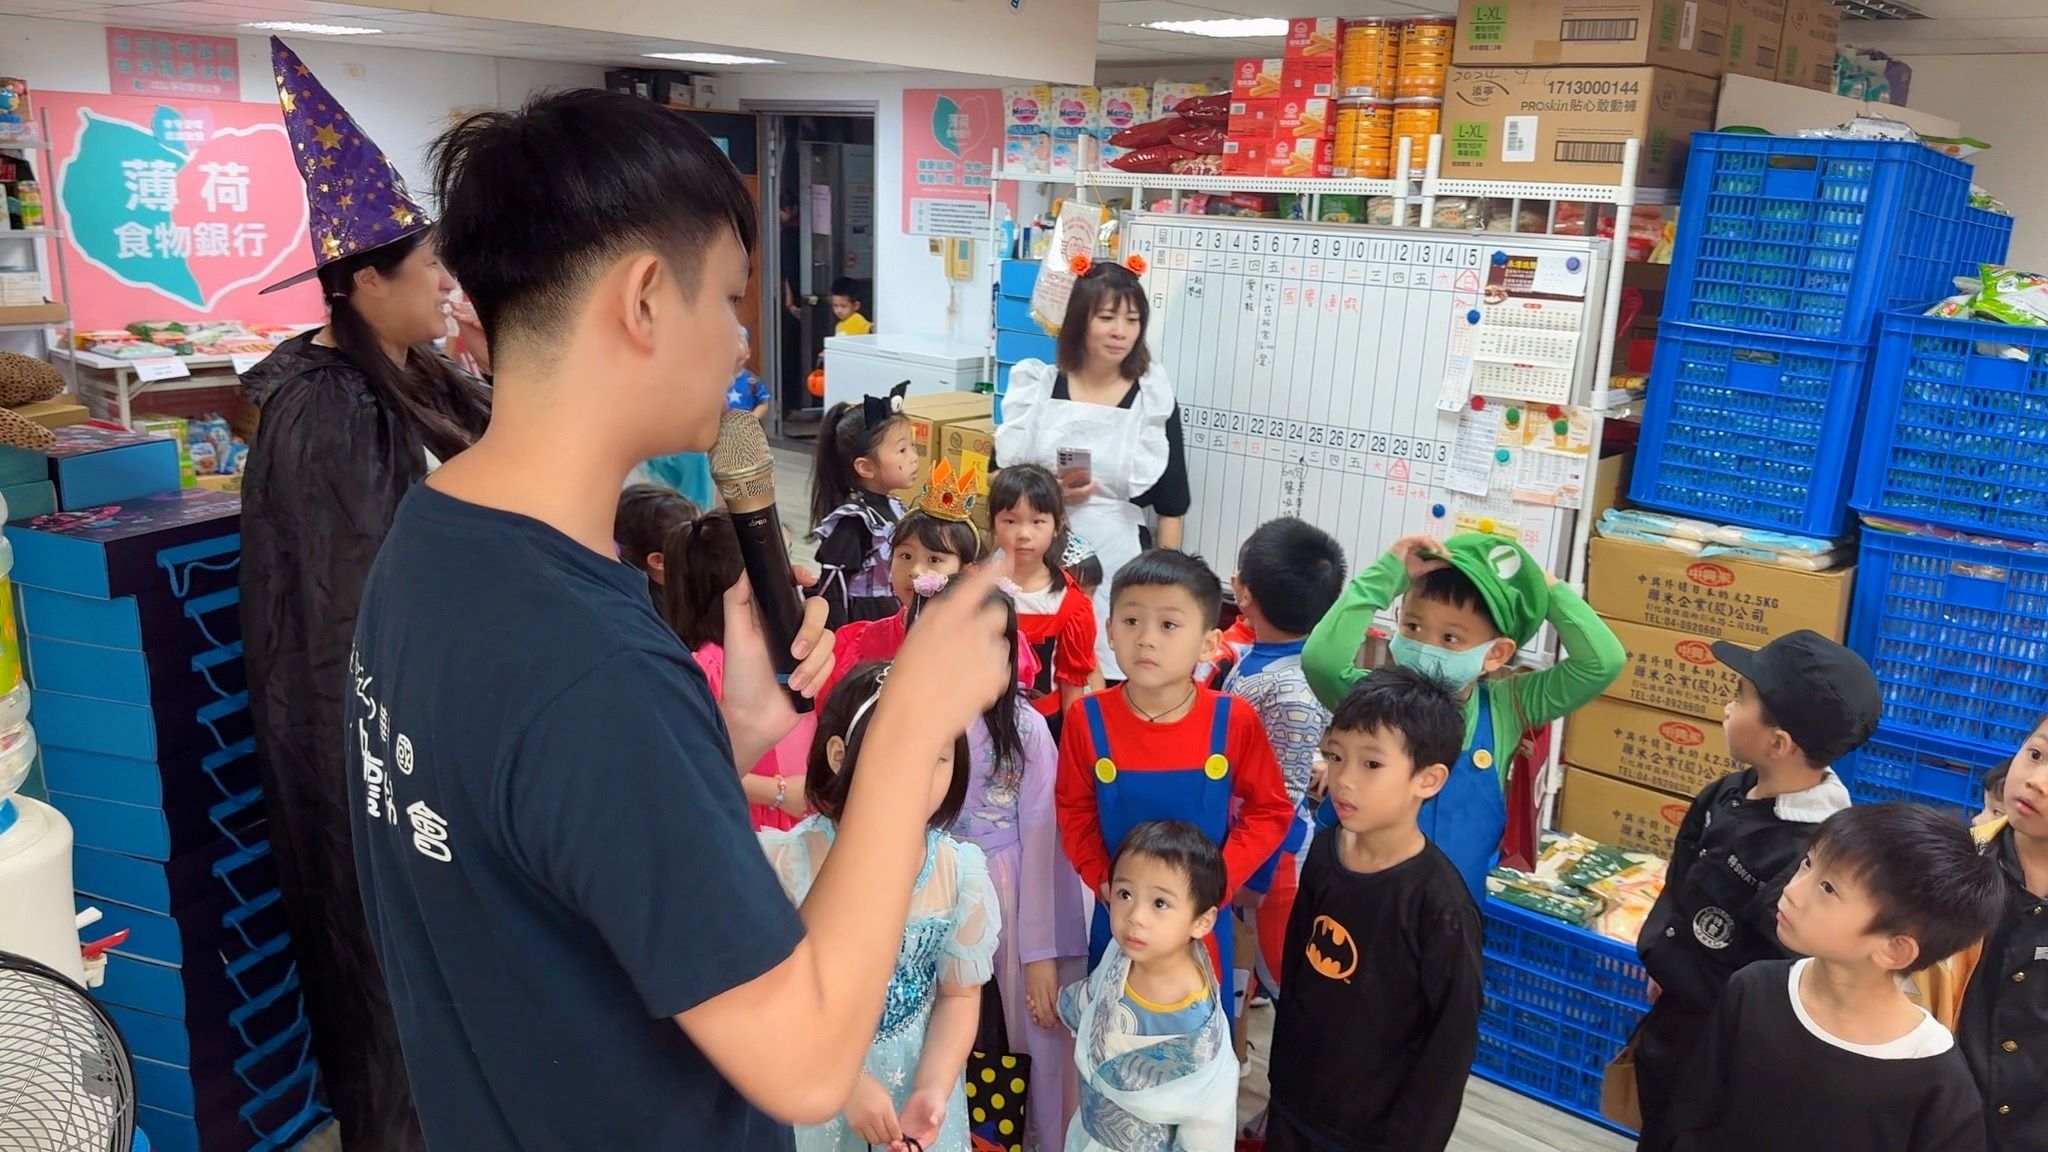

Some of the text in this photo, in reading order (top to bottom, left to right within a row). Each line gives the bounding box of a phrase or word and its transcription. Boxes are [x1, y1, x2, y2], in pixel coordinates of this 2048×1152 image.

[1476, 7, 1502, 20] L-XL
[1549, 81, 1639, 96] 1713000144
[1458, 125, 1484, 138] L-XL
[121, 158, 250, 213] 薄荷
[113, 222, 268, 261] 食物銀行
[1178, 230, 1477, 266] 1 2 3 4 5 6 7 8 9 10 11 12 13 14 15
[1194, 408, 1207, 426] 19
[1213, 412, 1227, 429] 20
[1232, 414, 1244, 431] 21
[1251, 418, 1264, 434] 22
[1270, 420, 1283, 437] 23
[1289, 423, 1303, 439] 24
[1309, 426, 1323, 443] 25
[1329, 429, 1344, 446] 26
[1350, 432, 1365, 449] 27
[1371, 435, 1386, 452] 28
[1393, 438, 1408, 456] 29
[1415, 442, 1431, 459] 30
[1634, 664, 1739, 699] 聯米企業(股)公
